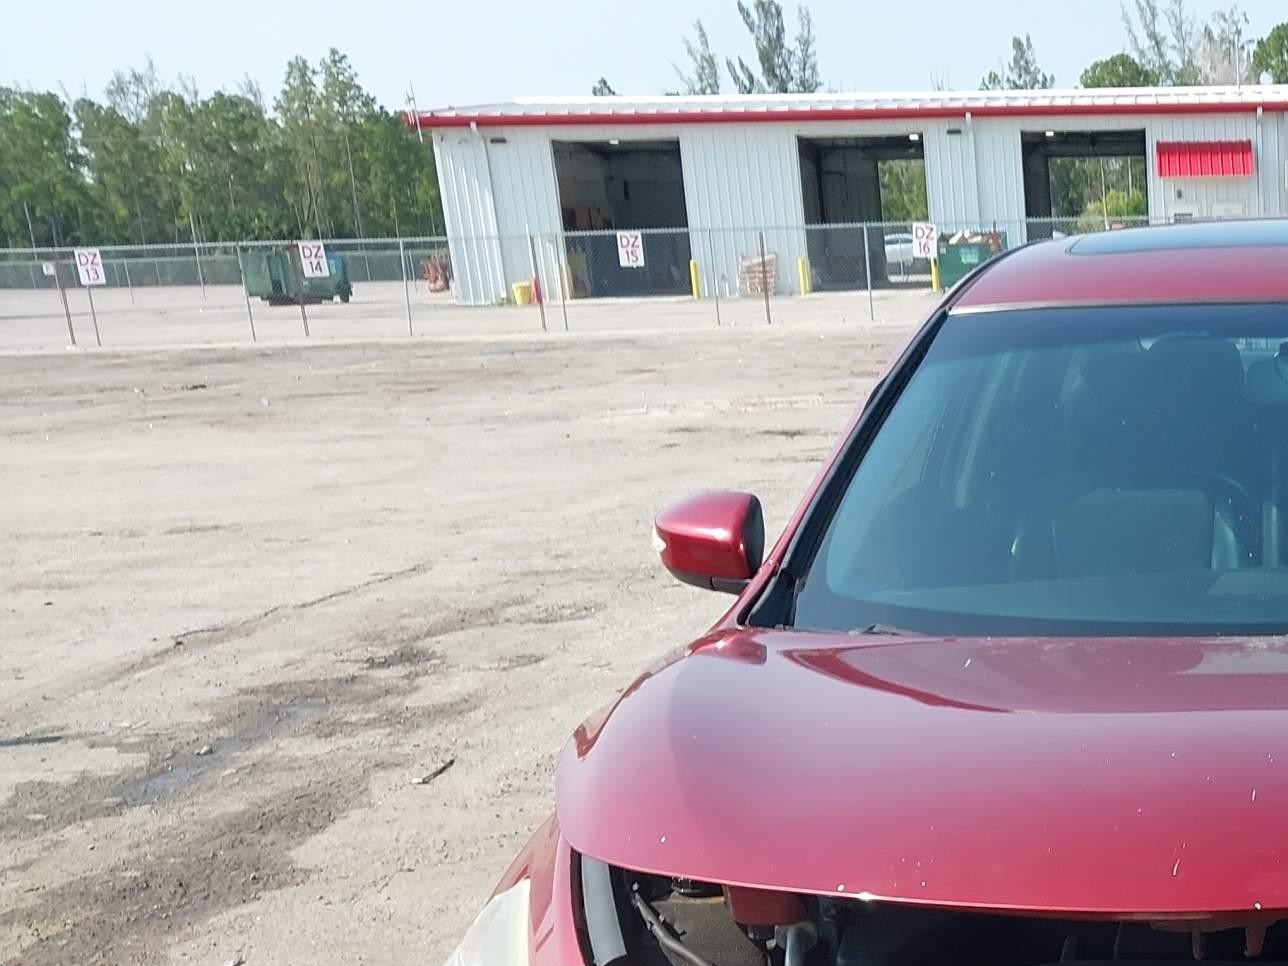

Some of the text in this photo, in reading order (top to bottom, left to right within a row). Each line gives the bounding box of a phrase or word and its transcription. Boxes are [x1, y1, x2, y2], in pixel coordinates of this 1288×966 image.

[915, 226, 934, 240] DZ
[620, 235, 640, 248] DZ
[919, 241, 931, 255] 16
[302, 245, 323, 258] DZ
[625, 250, 639, 264] 15
[78, 253, 99, 266] DZ
[310, 261, 323, 273] 14
